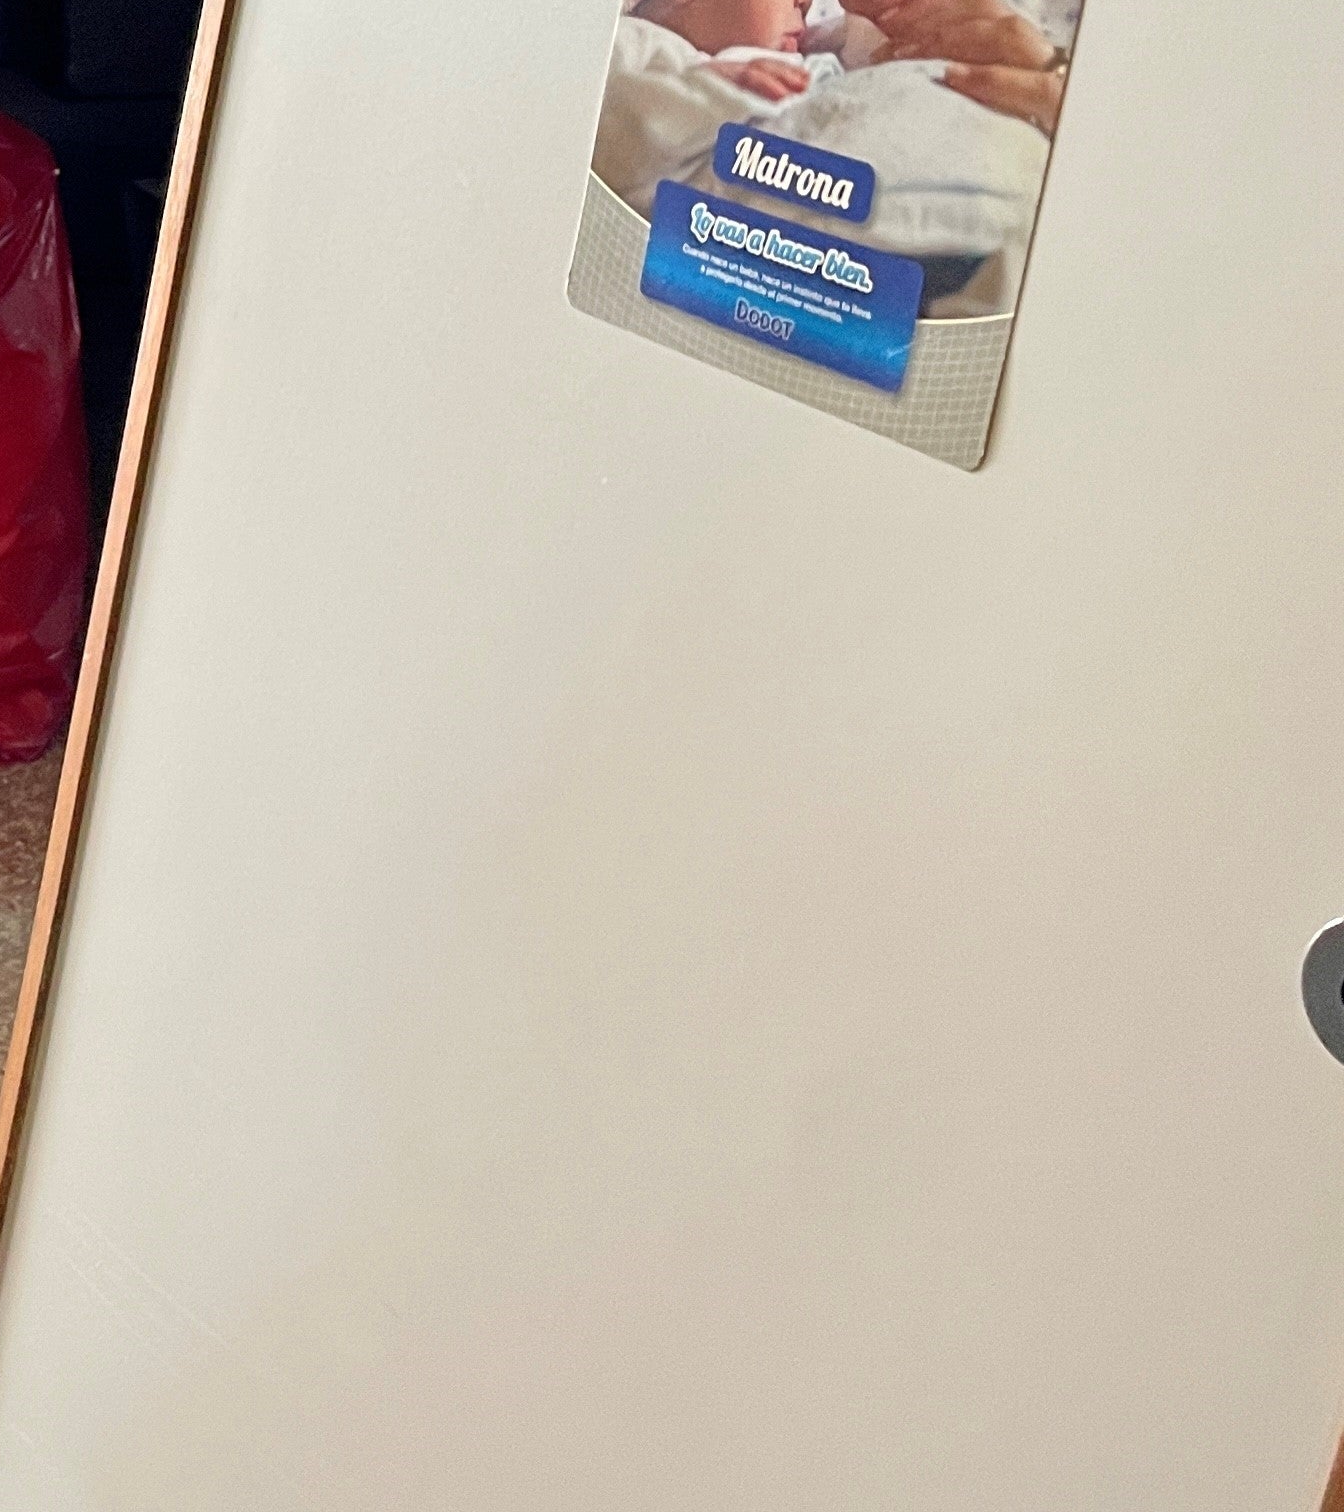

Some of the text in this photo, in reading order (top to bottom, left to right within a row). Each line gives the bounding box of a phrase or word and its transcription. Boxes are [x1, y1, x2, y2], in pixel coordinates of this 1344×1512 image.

[732, 137, 856, 210] Matrona
[691, 202, 874, 294] Lo vas a hacer bien.
[735, 297, 795, 340] DODOT
